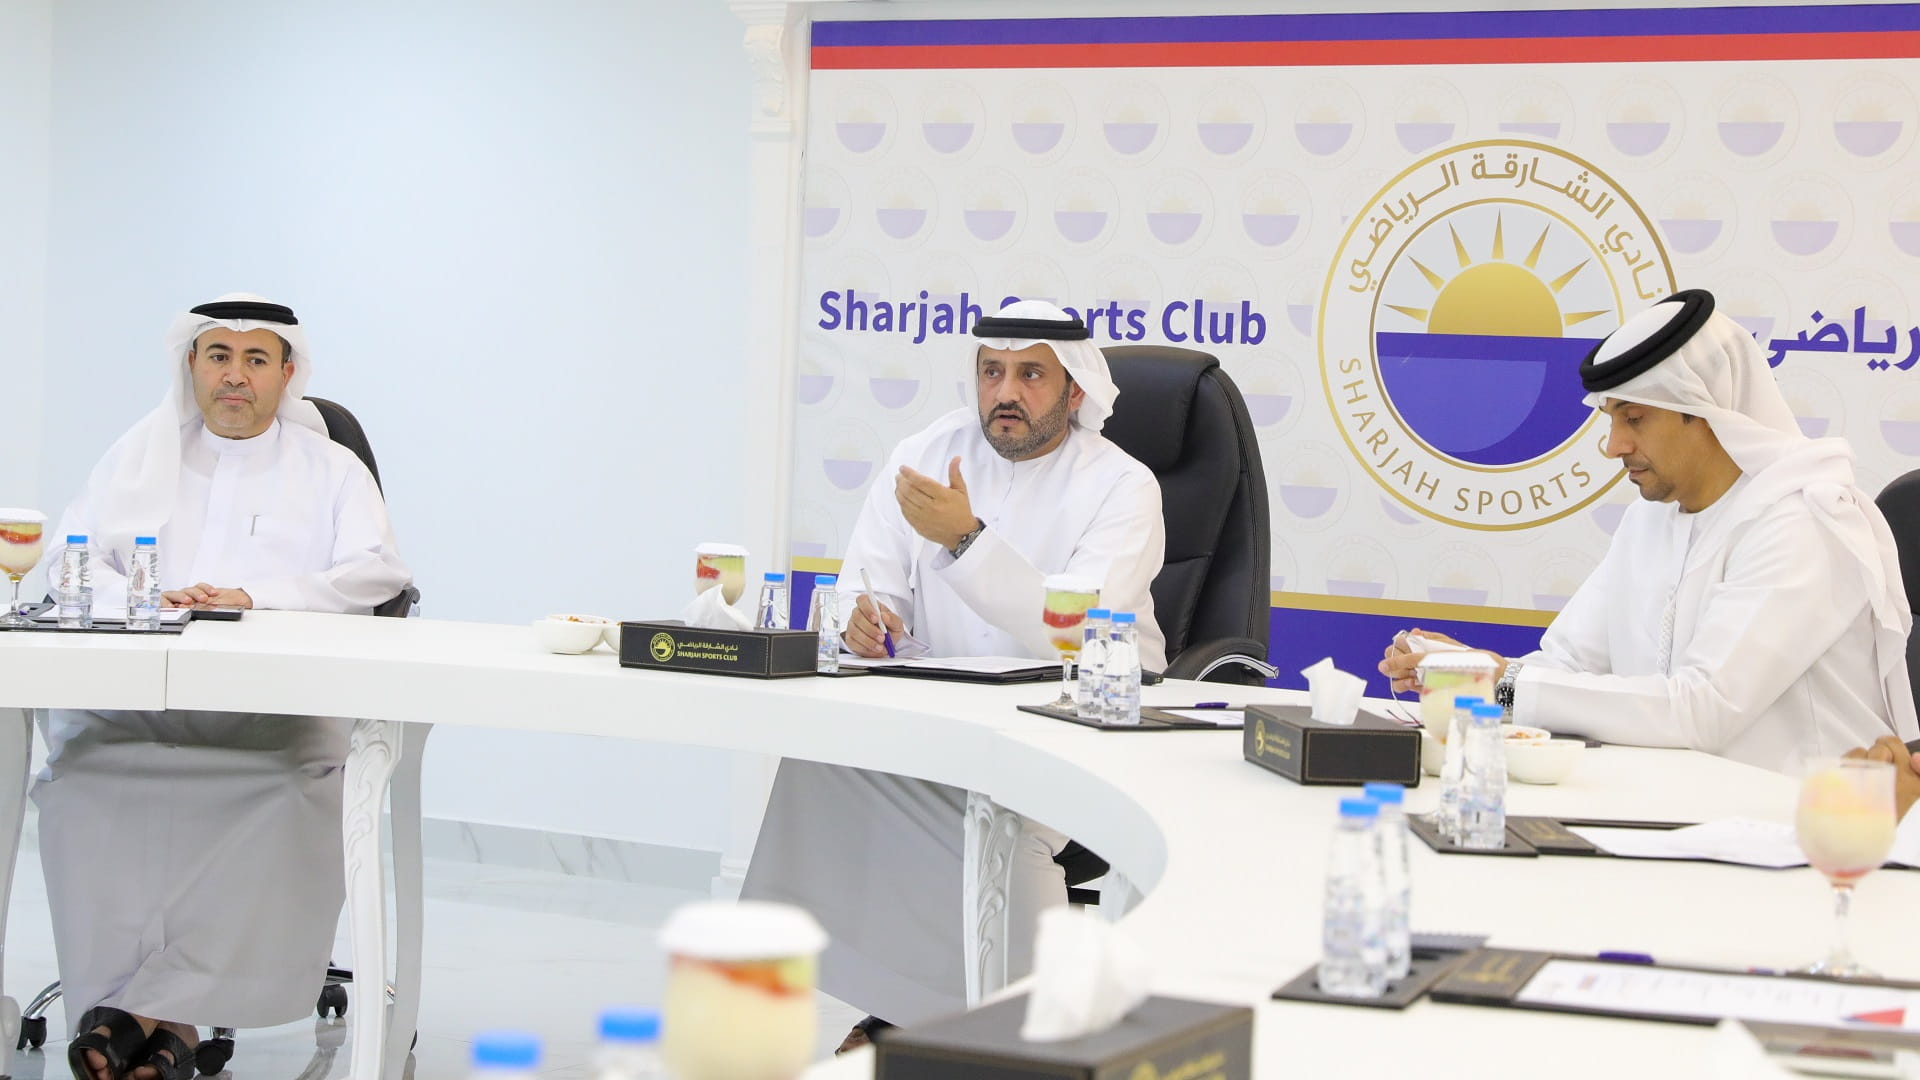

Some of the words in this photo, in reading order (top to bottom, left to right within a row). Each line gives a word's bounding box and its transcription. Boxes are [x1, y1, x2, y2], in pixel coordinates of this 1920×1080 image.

[1471, 152, 1615, 219] الشارقة
[1348, 161, 1460, 293] الرياضي
[1599, 224, 1663, 299] نادي
[818, 289, 983, 344] Sharjah
[1161, 299, 1267, 345] Club
[1339, 357, 1441, 501] SHARJAH
[1454, 461, 1591, 515] SPORTS
[677, 650, 701, 658] SHARJAH
[702, 652, 723, 660] SPORTS
